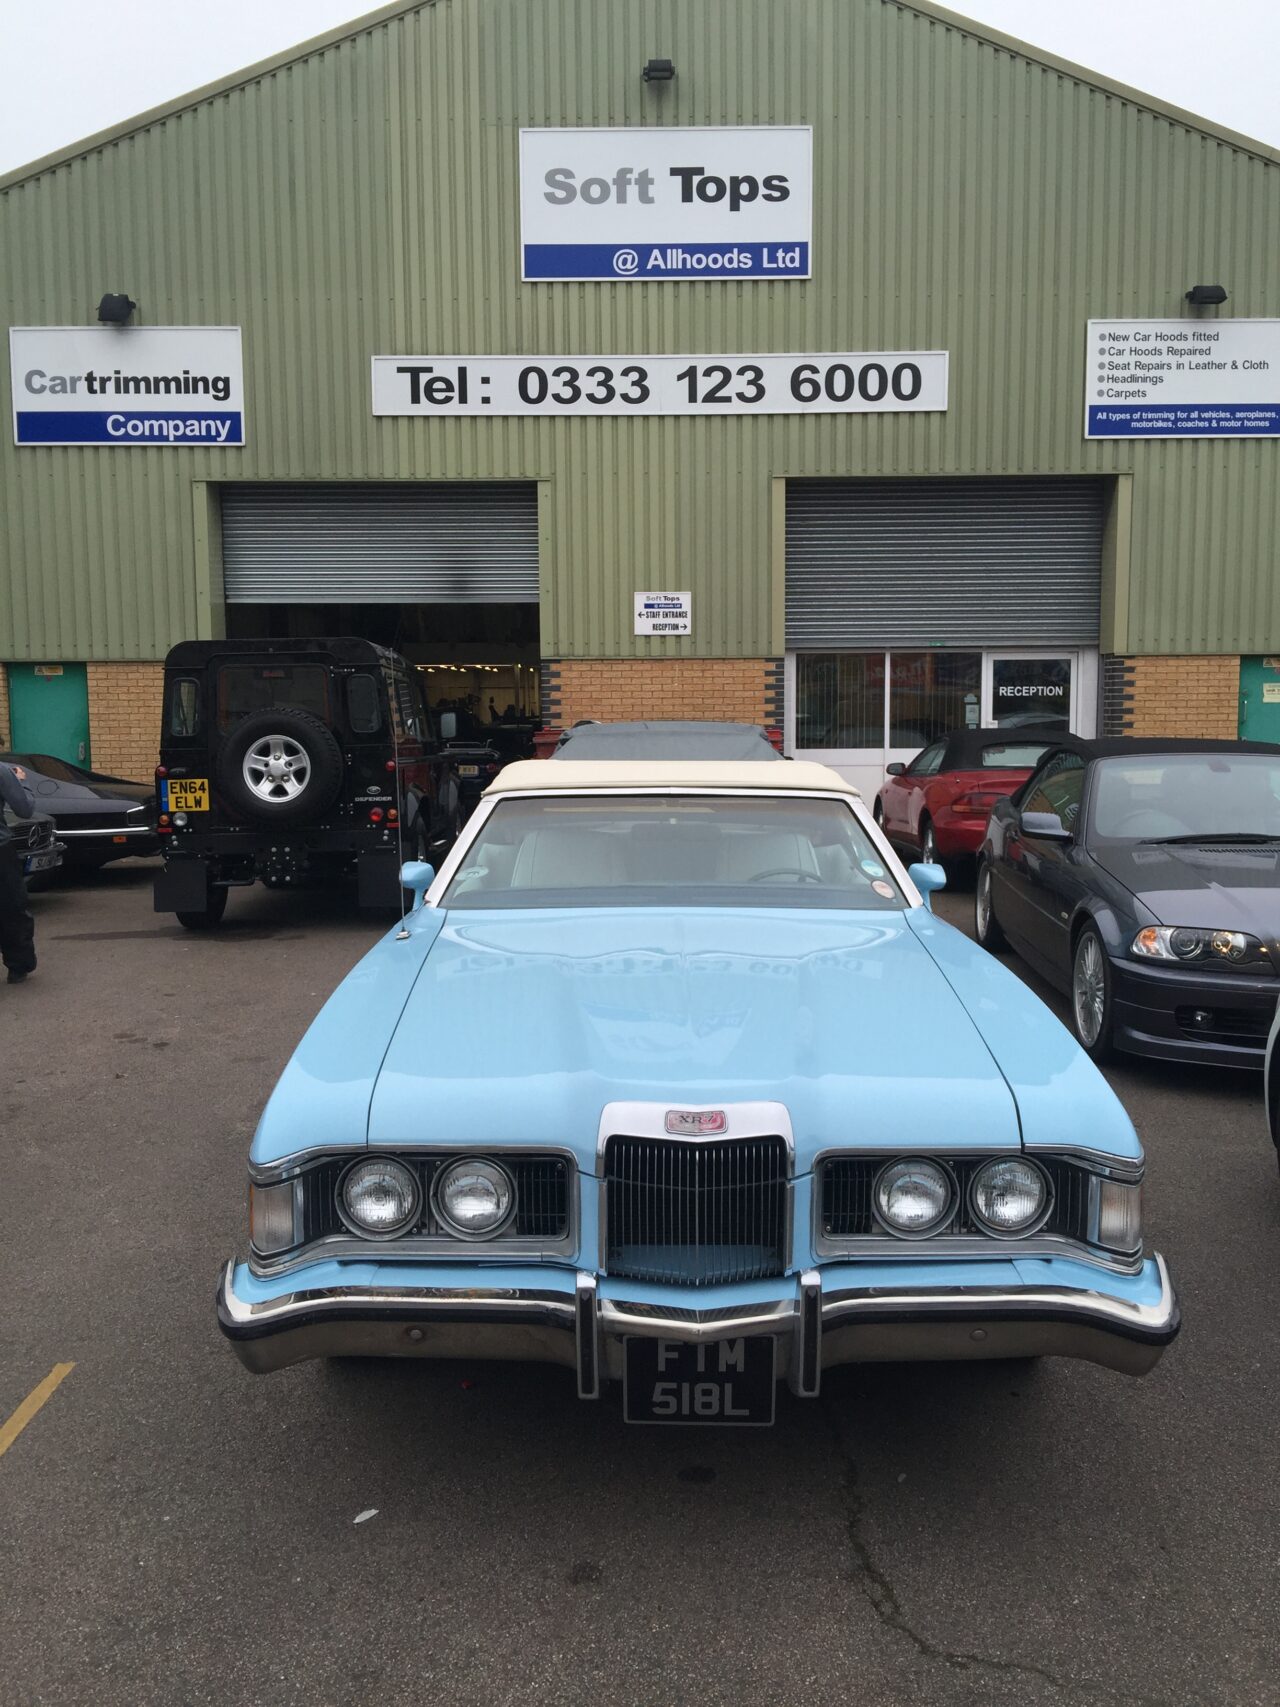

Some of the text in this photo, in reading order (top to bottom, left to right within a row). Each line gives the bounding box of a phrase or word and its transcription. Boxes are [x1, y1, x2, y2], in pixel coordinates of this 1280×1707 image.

[543, 166, 790, 212] Soft Tops
[613, 247, 800, 275] @ Allhoods Ltd
[1108, 331, 1220, 342] New Car Hoods fitted
[1107, 346, 1211, 358] Car Hoods Repaired
[1107, 360, 1269, 372] Seat Repairs in Leather & Cloth
[396, 362, 922, 405] Tel: 0333 123 6000
[1107, 374, 1164, 386] Headlinings
[1106, 388, 1147, 400] Carpets
[1096, 412, 1107, 420] All
[1109, 412, 1131, 421] types
[1132, 412, 1141, 420] of
[1142, 411, 1175, 420] trimming
[1177, 411, 1188, 419] for
[1200, 411, 1233, 419] vehicles,
[1235, 410, 1279, 420] aeroplanes,
[106, 414, 231, 441] Company
[1131, 420, 1175, 428] motorbikes,
[1177, 420, 1209, 428] coaches
[1211, 419, 1218, 427] &
[1244, 419, 1270, 427] homes
[652, 623, 679, 631] RECEPTION
[999, 686, 1063, 696] RECEPTION
[170, 781, 206, 794] EN64
[175, 796, 202, 808] ELW
[652, 1382, 750, 1416] 518L
